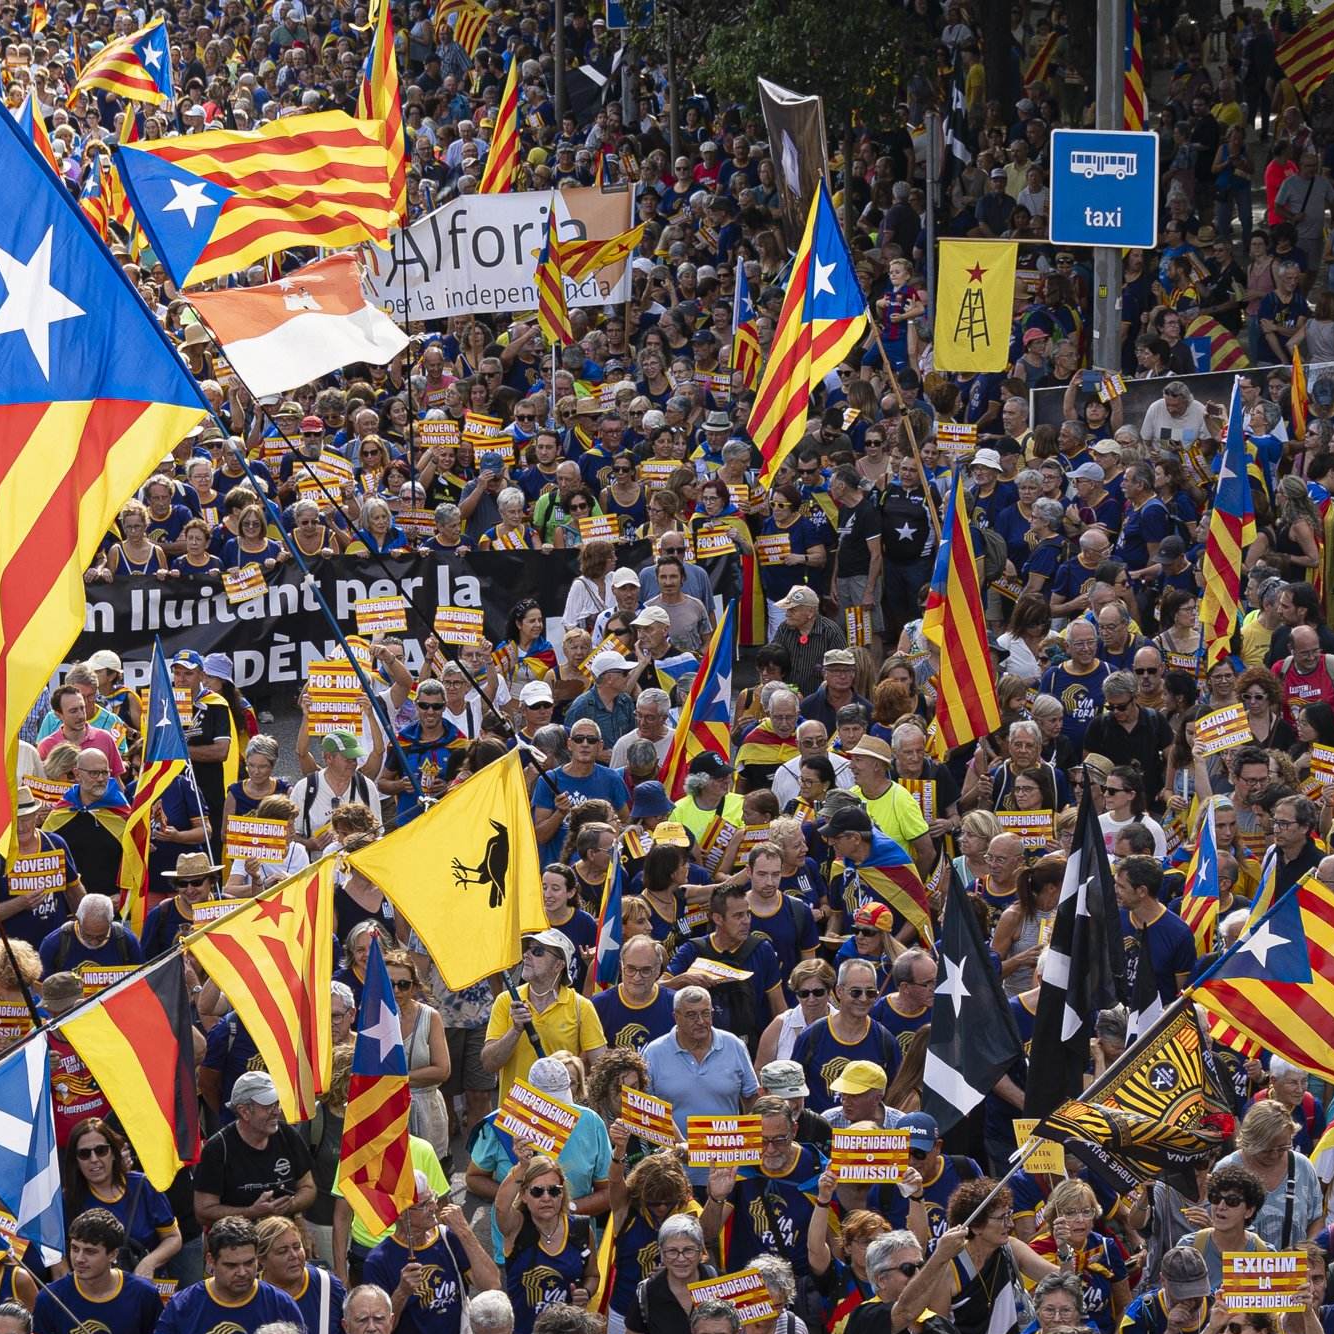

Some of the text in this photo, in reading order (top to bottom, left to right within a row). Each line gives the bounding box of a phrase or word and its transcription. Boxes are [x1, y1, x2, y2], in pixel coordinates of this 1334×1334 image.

[1084, 207, 1122, 228] taxi
[141, 578, 331, 633] lluitant
[334, 576, 415, 616] per
[436, 563, 483, 607] la
[311, 674, 362, 691] FOC NOU
[1077, 698, 1094, 709] VIA
[1199, 710, 1238, 730] EXIGIM
[227, 820, 285, 837] INDEPENDÈNCIA
[227, 844, 283, 860] INDEPENDÈNCIA
[11, 857, 58, 873] GOVERN
[8, 872, 61, 891] DIMISSIÓ
[511, 1083, 576, 1128] INDEPENDÈNCIA
[626, 1092, 666, 1117] EXIGIM
[641, 1114, 651, 1126] LA
[711, 1120, 738, 1131] VAM
[503, 1117, 556, 1150] DIMISSIÓ
[706, 1134, 744, 1147] VOTAR
[834, 1133, 907, 1151] INDEPENDÈNCIA
[689, 1148, 760, 1162] INDEPENDÈNCIA
[839, 1164, 899, 1181] DIMISSIÓ
[1233, 1256, 1297, 1274] EXIGIM
[690, 1273, 763, 1303] INDEPENDÈNCIA
[1258, 1276, 1273, 1290] LA
